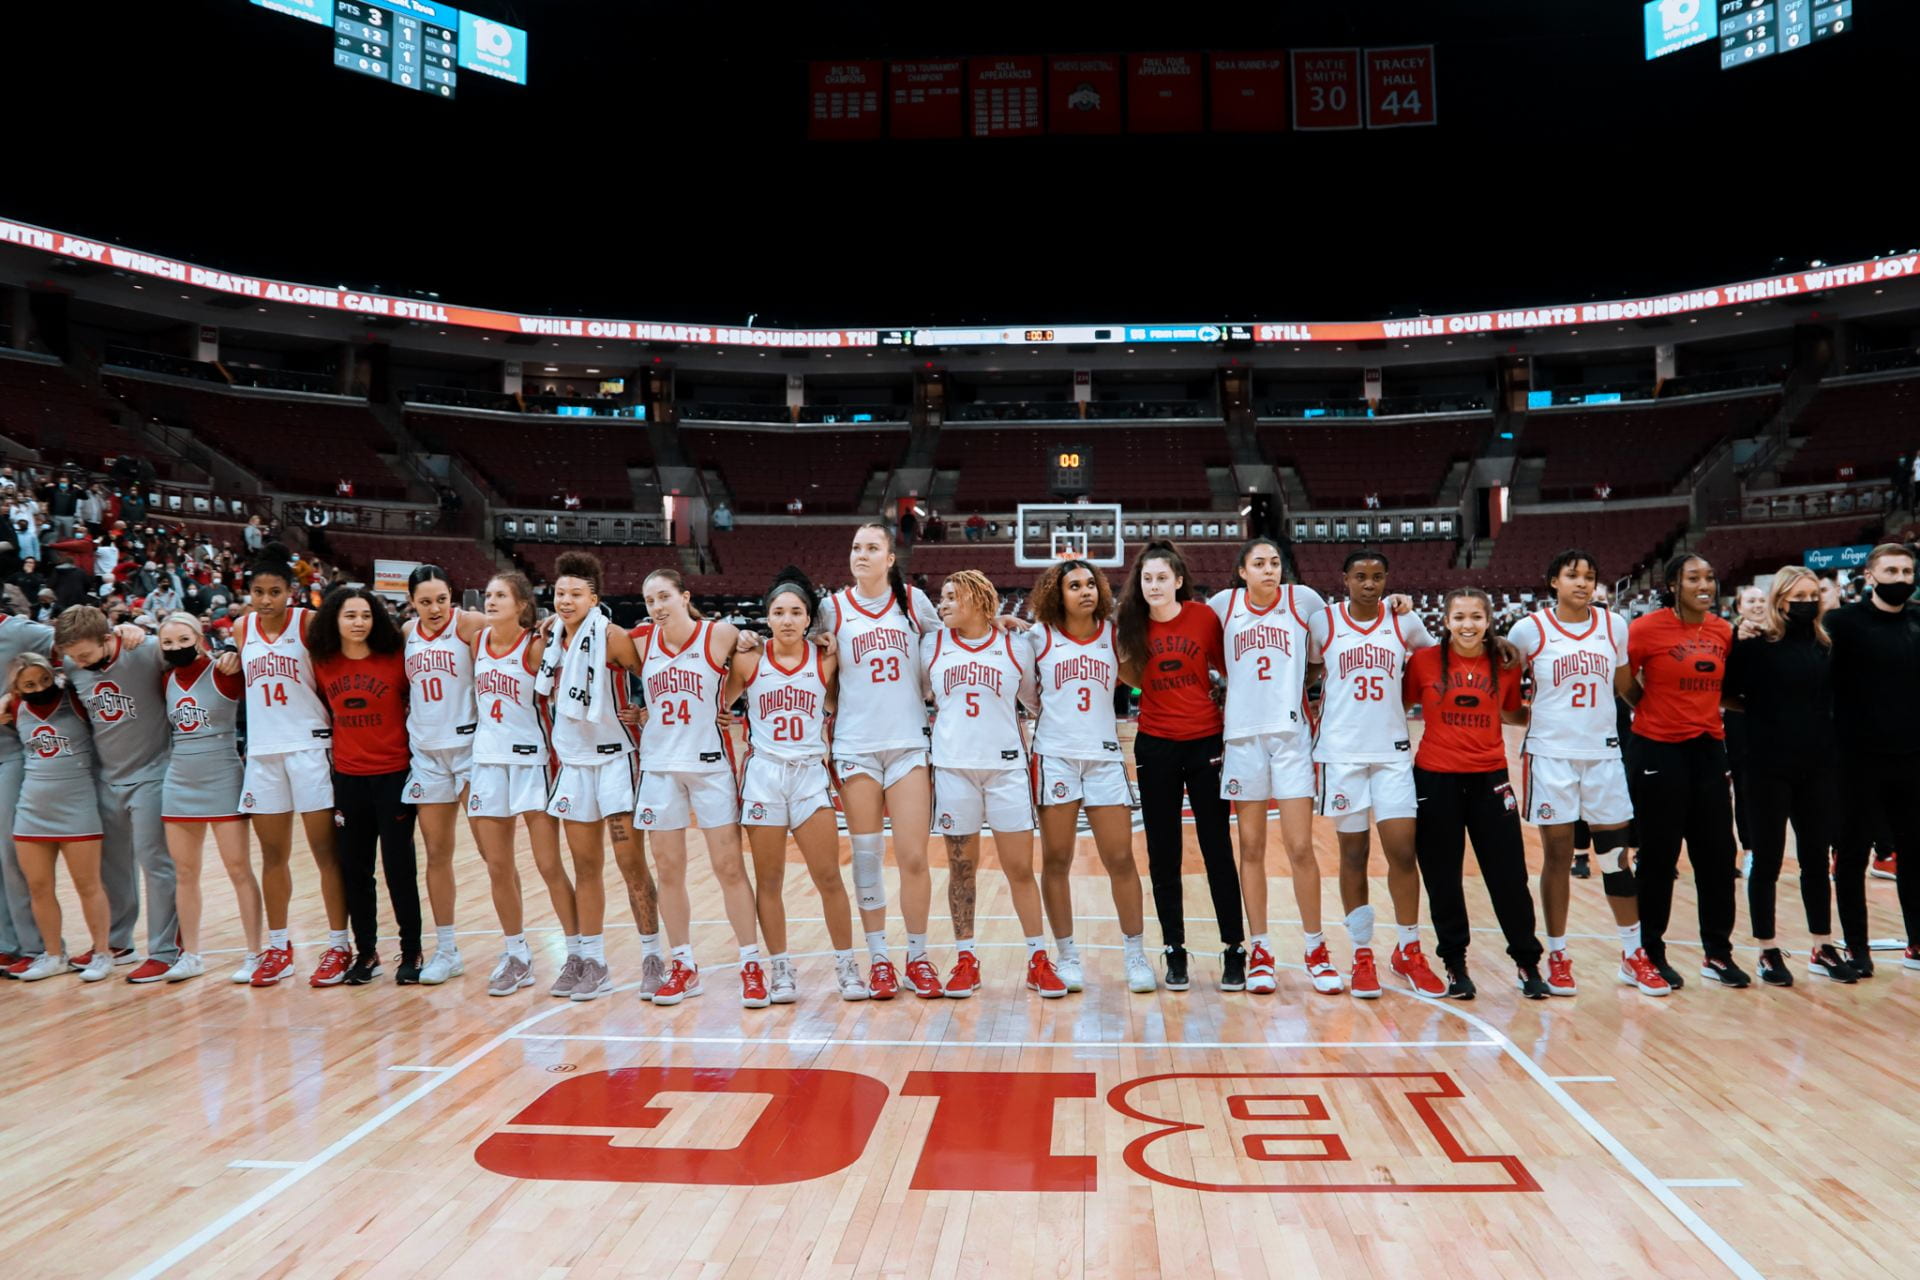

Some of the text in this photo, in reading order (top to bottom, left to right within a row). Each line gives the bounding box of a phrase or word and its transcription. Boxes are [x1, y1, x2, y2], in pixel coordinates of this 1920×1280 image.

[339, 2, 360, 16] PTS
[369, 9, 382, 25] 3
[1722, 0, 1742, 14] PTS
[399, 17, 416, 28] REB
[399, 42, 415, 51] OFF
[473, 19, 512, 57] 10
[399, 64, 414, 73] DEF
[1304, 59, 1345, 70] KATIE
[1374, 57, 1425, 71] TRACEY
[1304, 72, 1347, 82] SMITH
[1383, 74, 1416, 86] HALL
[1309, 85, 1347, 112] 30
[1381, 90, 1422, 116] 44
[59, 237, 104, 261] JOY
[110, 248, 185, 280] WHICH
[191, 268, 260, 296] DEATH
[265, 284, 338, 306] ALONE
[344, 294, 389, 313] CAN
[394, 301, 448, 321] STILL
[1383, 256, 1918, 337] WHILE OUR HEARTS REBOUNDING THRILL WITH JOY
[519, 318, 582, 336] WHILE
[588, 323, 631, 337] OUR
[636, 325, 711, 342] HEARTS
[716, 329, 841, 346] REBOUNDING
[1261, 326, 1311, 340] STILL
[1809, 548, 1867, 567] Kroger Kroger
[870, 657, 900, 683] 23
[1257, 656, 1272, 681] 2
[261, 683, 288, 706] 14
[420, 677, 443, 702] 10
[1077, 687, 1091, 712] 3
[1354, 676, 1384, 701] 35
[1571, 683, 1597, 708] 21
[491, 699, 503, 723] 4
[661, 699, 691, 725] 24
[966, 693, 980, 718] 5
[773, 716, 803, 741] 20
